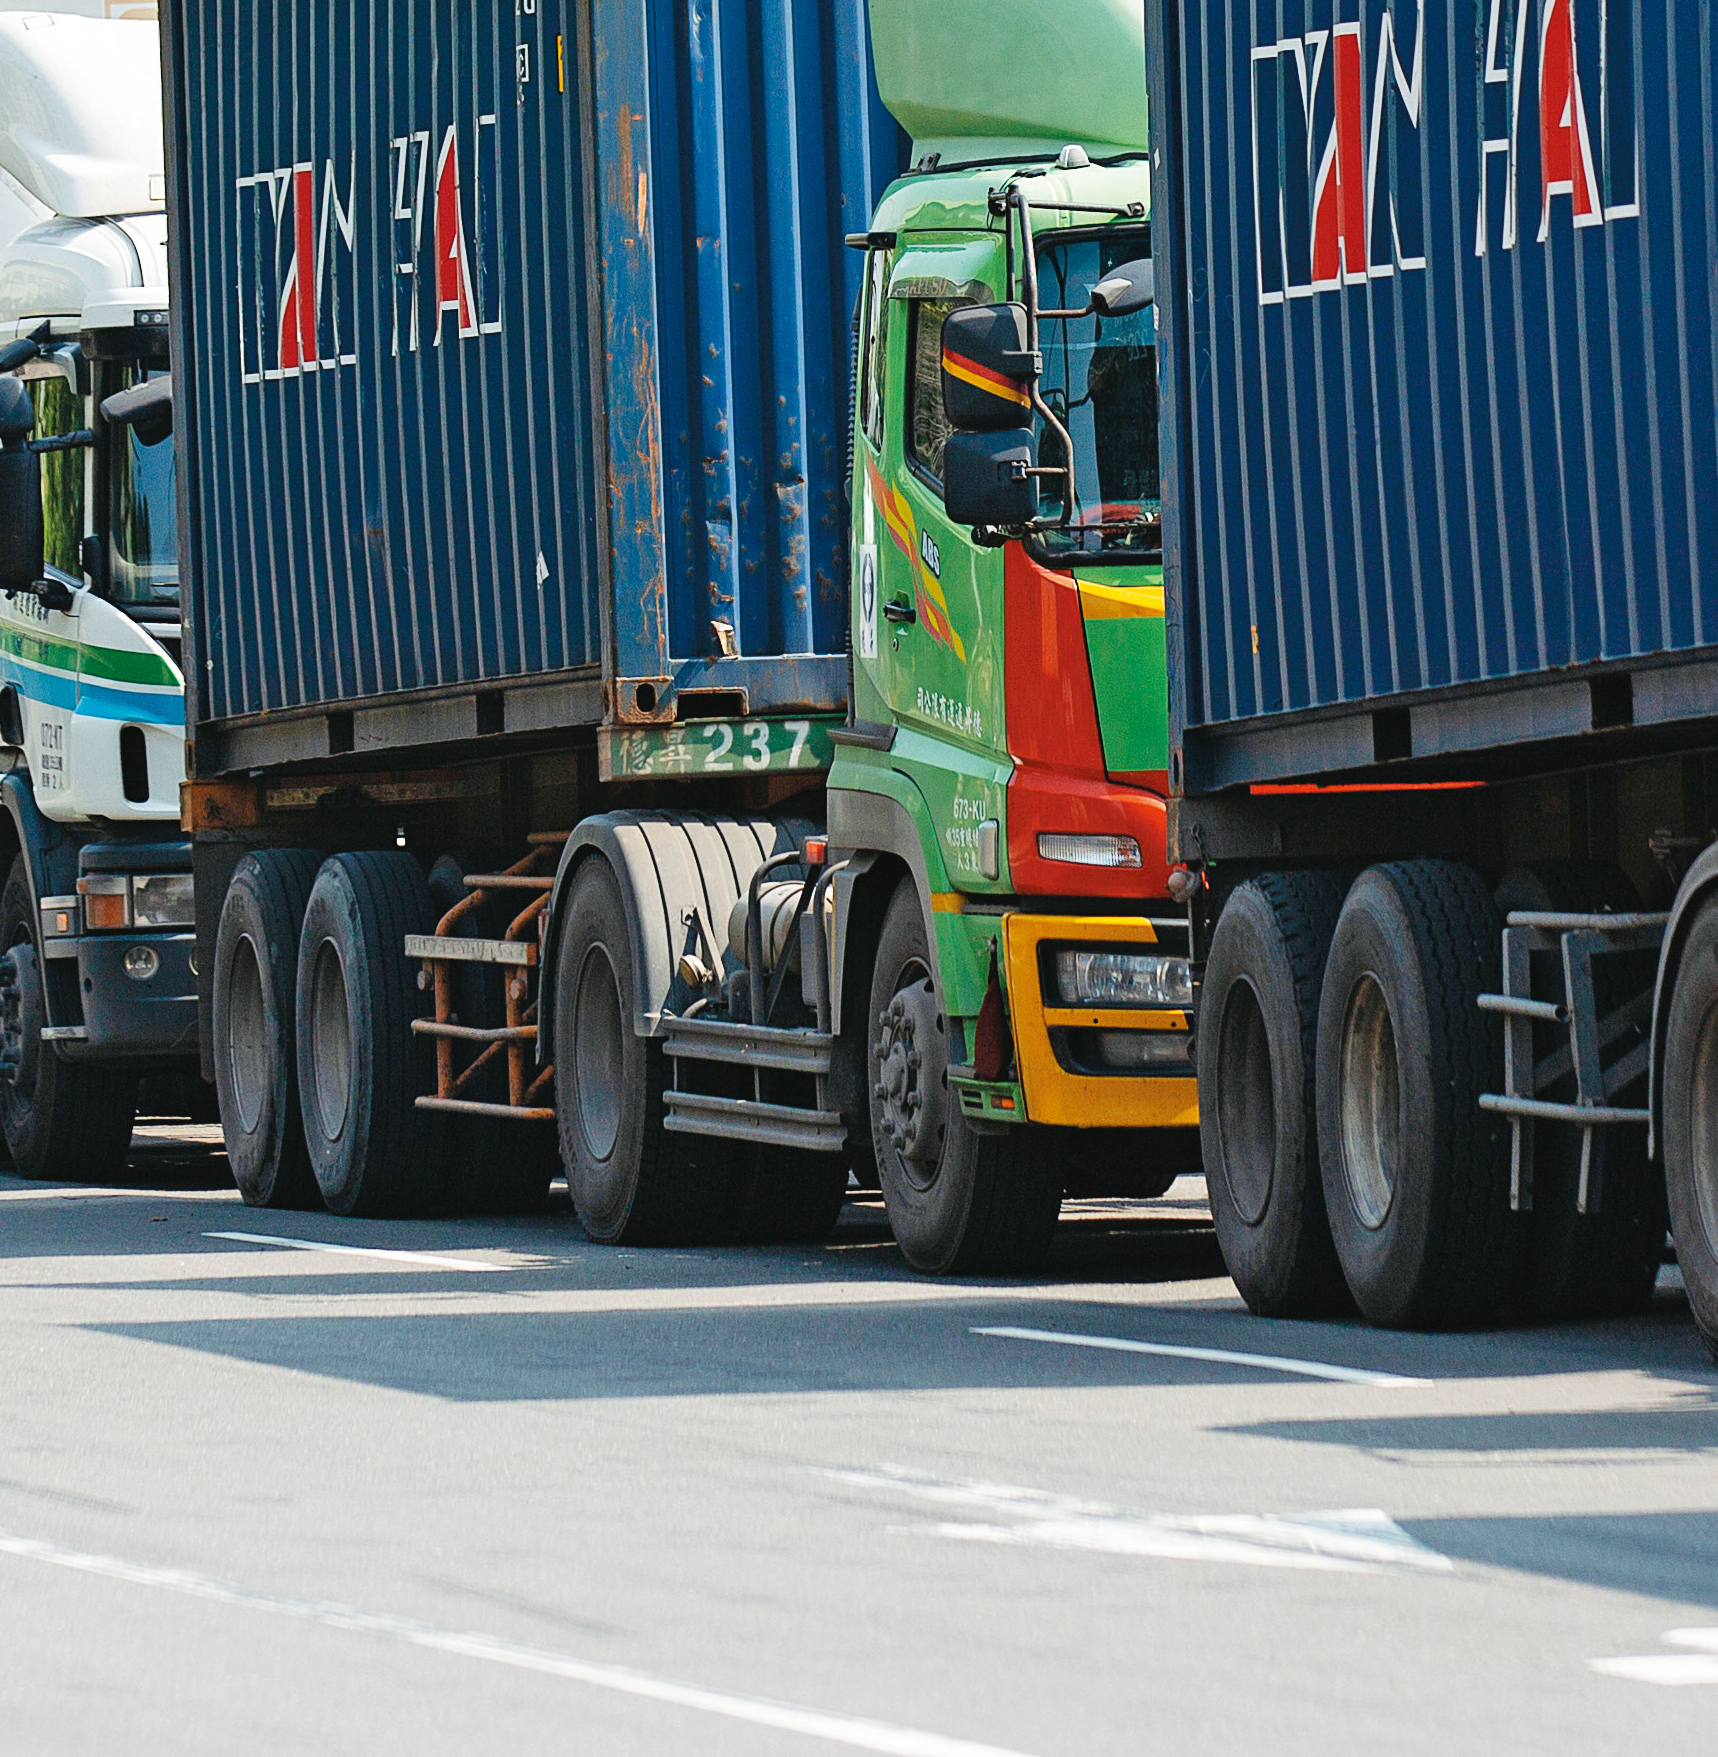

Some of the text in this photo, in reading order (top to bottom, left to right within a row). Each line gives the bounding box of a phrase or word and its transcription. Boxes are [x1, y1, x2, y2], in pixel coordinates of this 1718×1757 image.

[921, 528, 941, 579] ABS
[703, 720, 810, 772] 237
[953, 796, 986, 821] 673-KU
